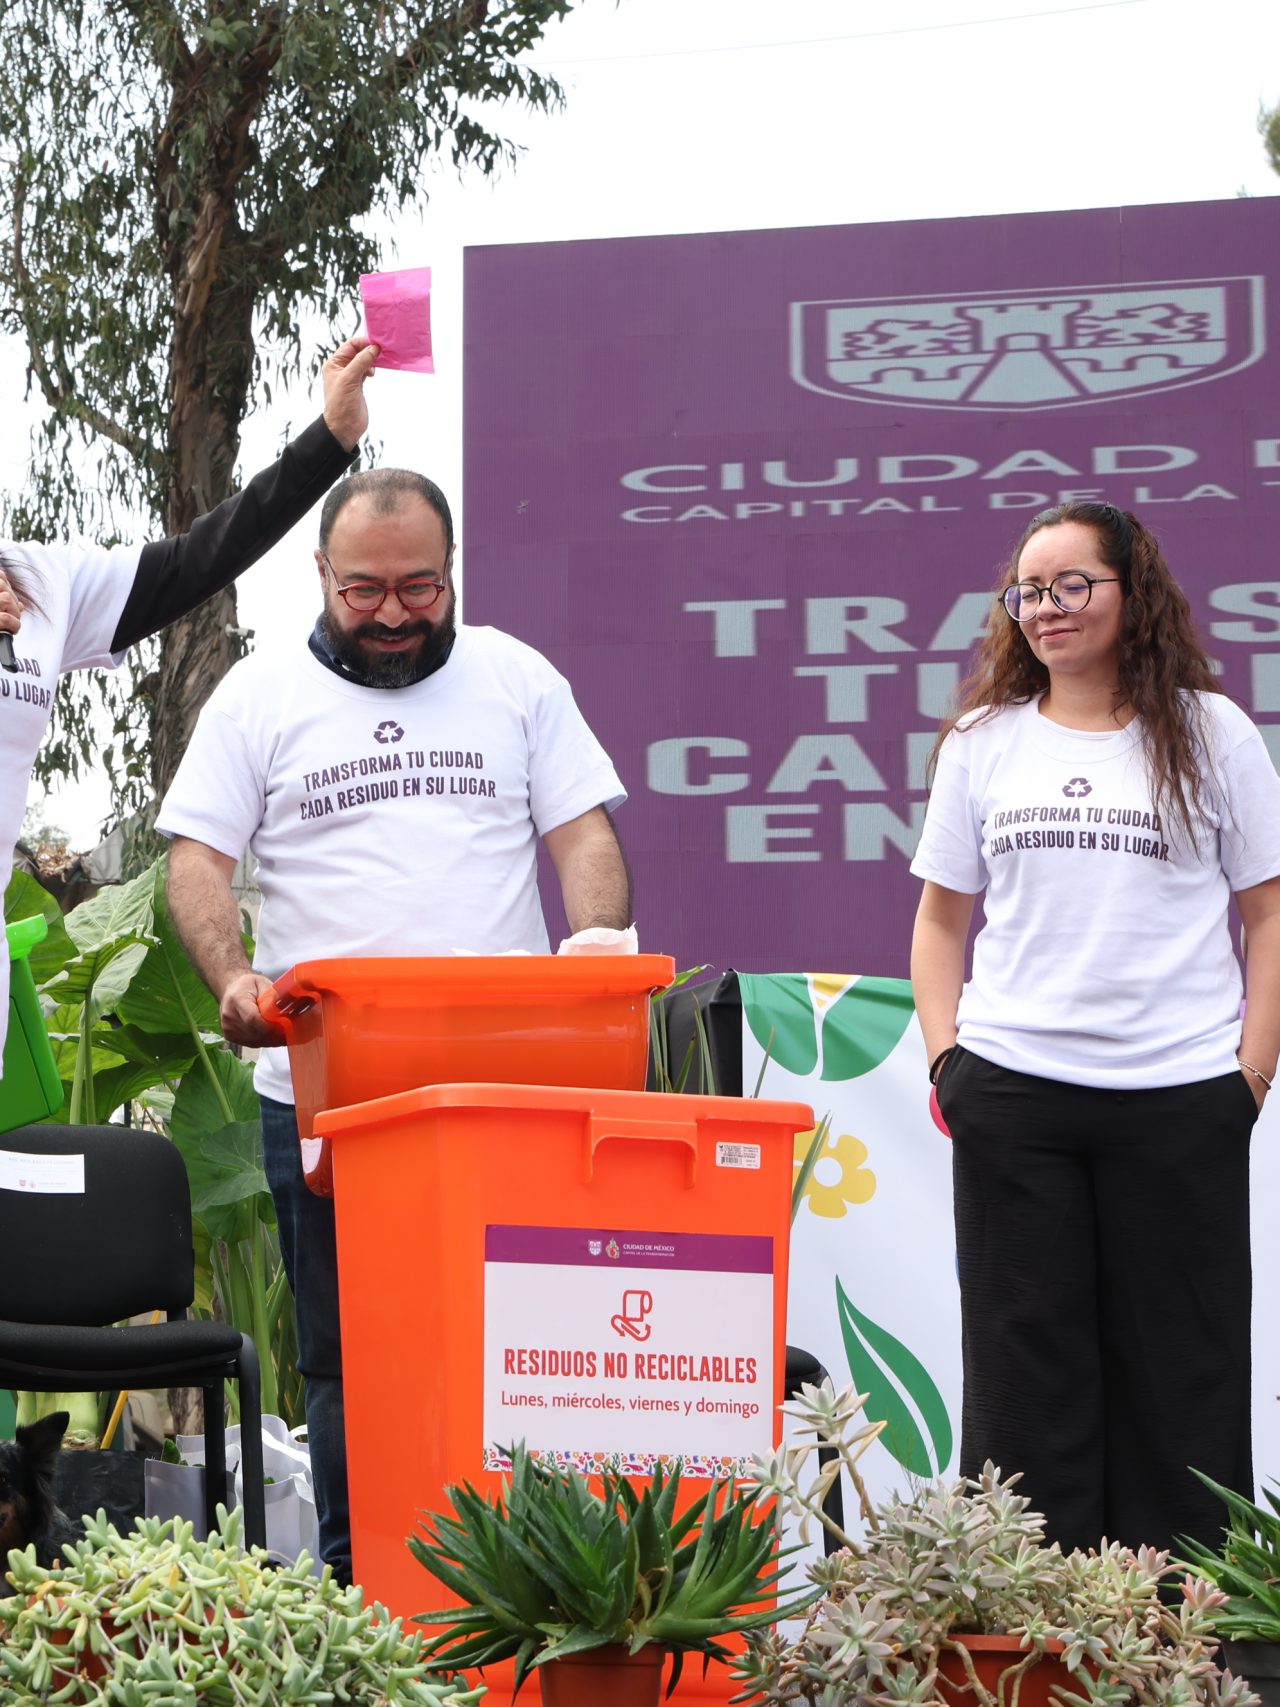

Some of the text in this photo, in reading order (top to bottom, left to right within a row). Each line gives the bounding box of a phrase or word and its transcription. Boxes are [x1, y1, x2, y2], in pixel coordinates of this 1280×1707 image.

[620, 445, 1198, 493] CIUDAD
[621, 483, 1238, 523] CAPITAL DE LA
[303, 750, 484, 793] TRANSFORMA TU CIUDAD
[300, 776, 496, 820] CADA RESIDUO EN SU LUGAR
[994, 807, 1162, 832] TRANSFORMA TU CIUDAD
[990, 830, 1169, 862] CADA RESIDUO EN SU LUGAR
[653, 1244, 675, 1252] MÉXICO
[504, 1348, 757, 1384] RESIDUOS NO RECICLABLES
[501, 1390, 760, 1419] Lunes, miércoles, viernes y domingo
